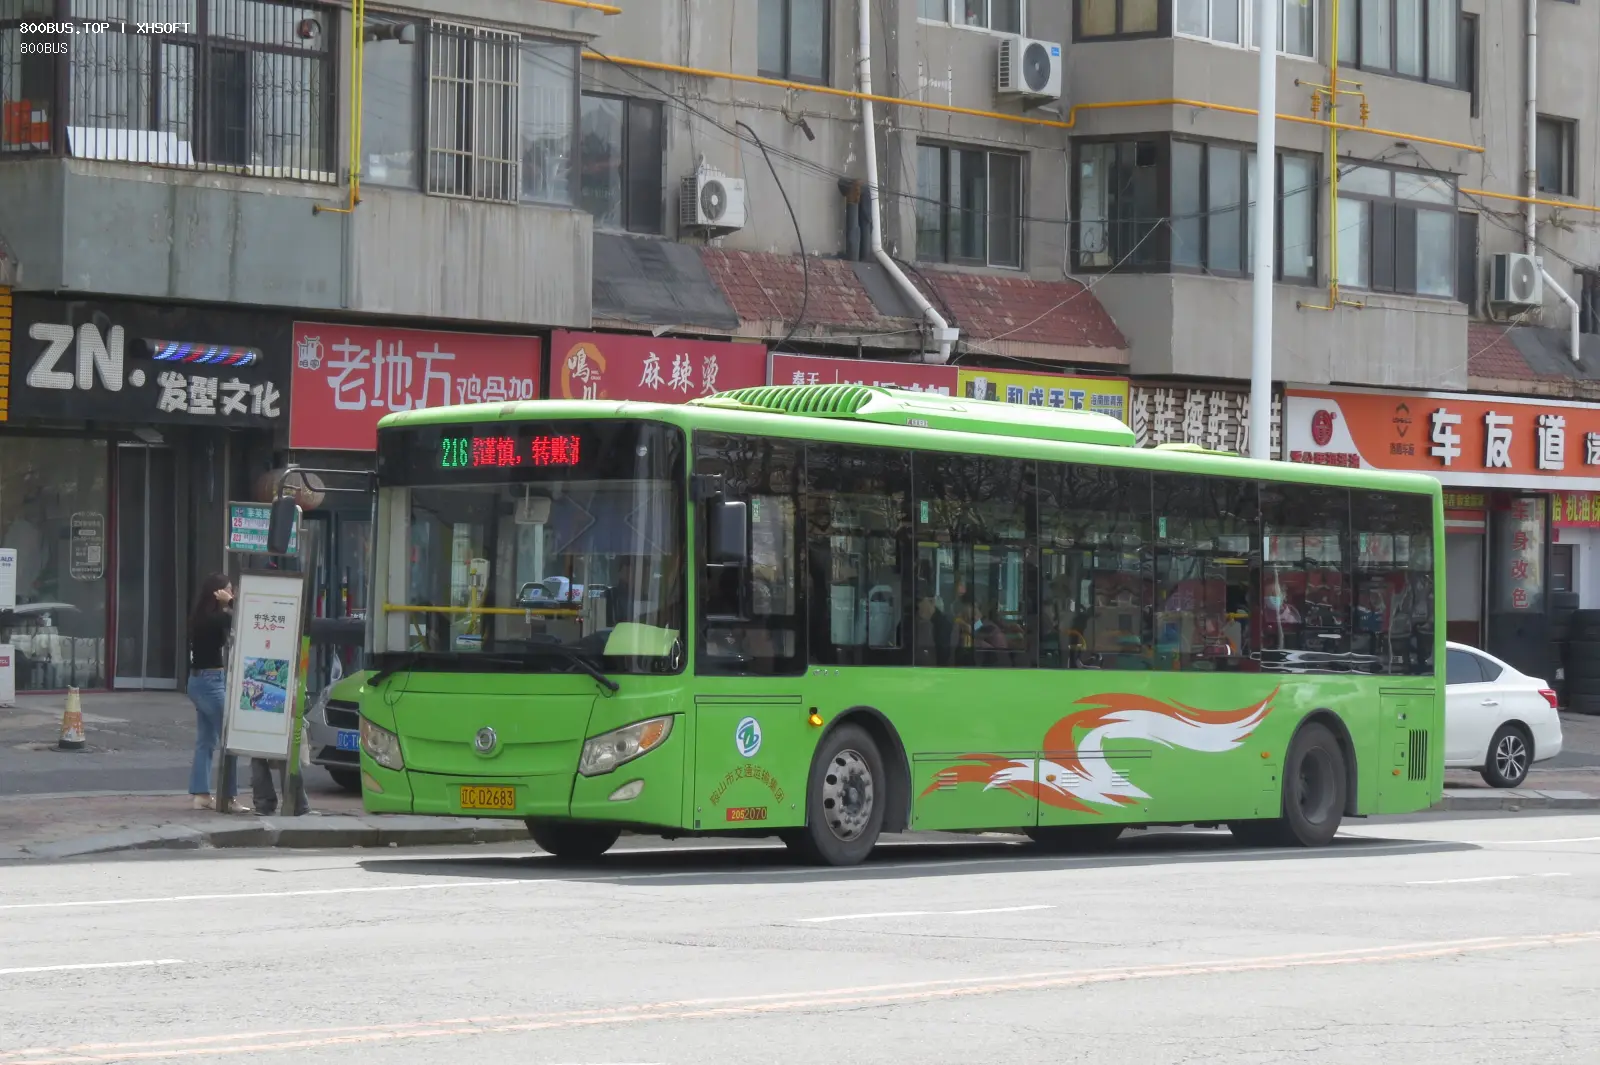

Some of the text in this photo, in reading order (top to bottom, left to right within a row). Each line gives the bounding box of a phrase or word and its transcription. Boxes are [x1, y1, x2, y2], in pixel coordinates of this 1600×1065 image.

[156, 370, 281, 418] 发型文化
[327, 337, 456, 412] 老地方
[638, 352, 720, 394] 麻辣烫
[442, 438, 468, 467] 216
[1429, 407, 1566, 471] 车友道
[253, 622, 285, 631] 天人合一
[254, 614, 286, 623] 中华文明
